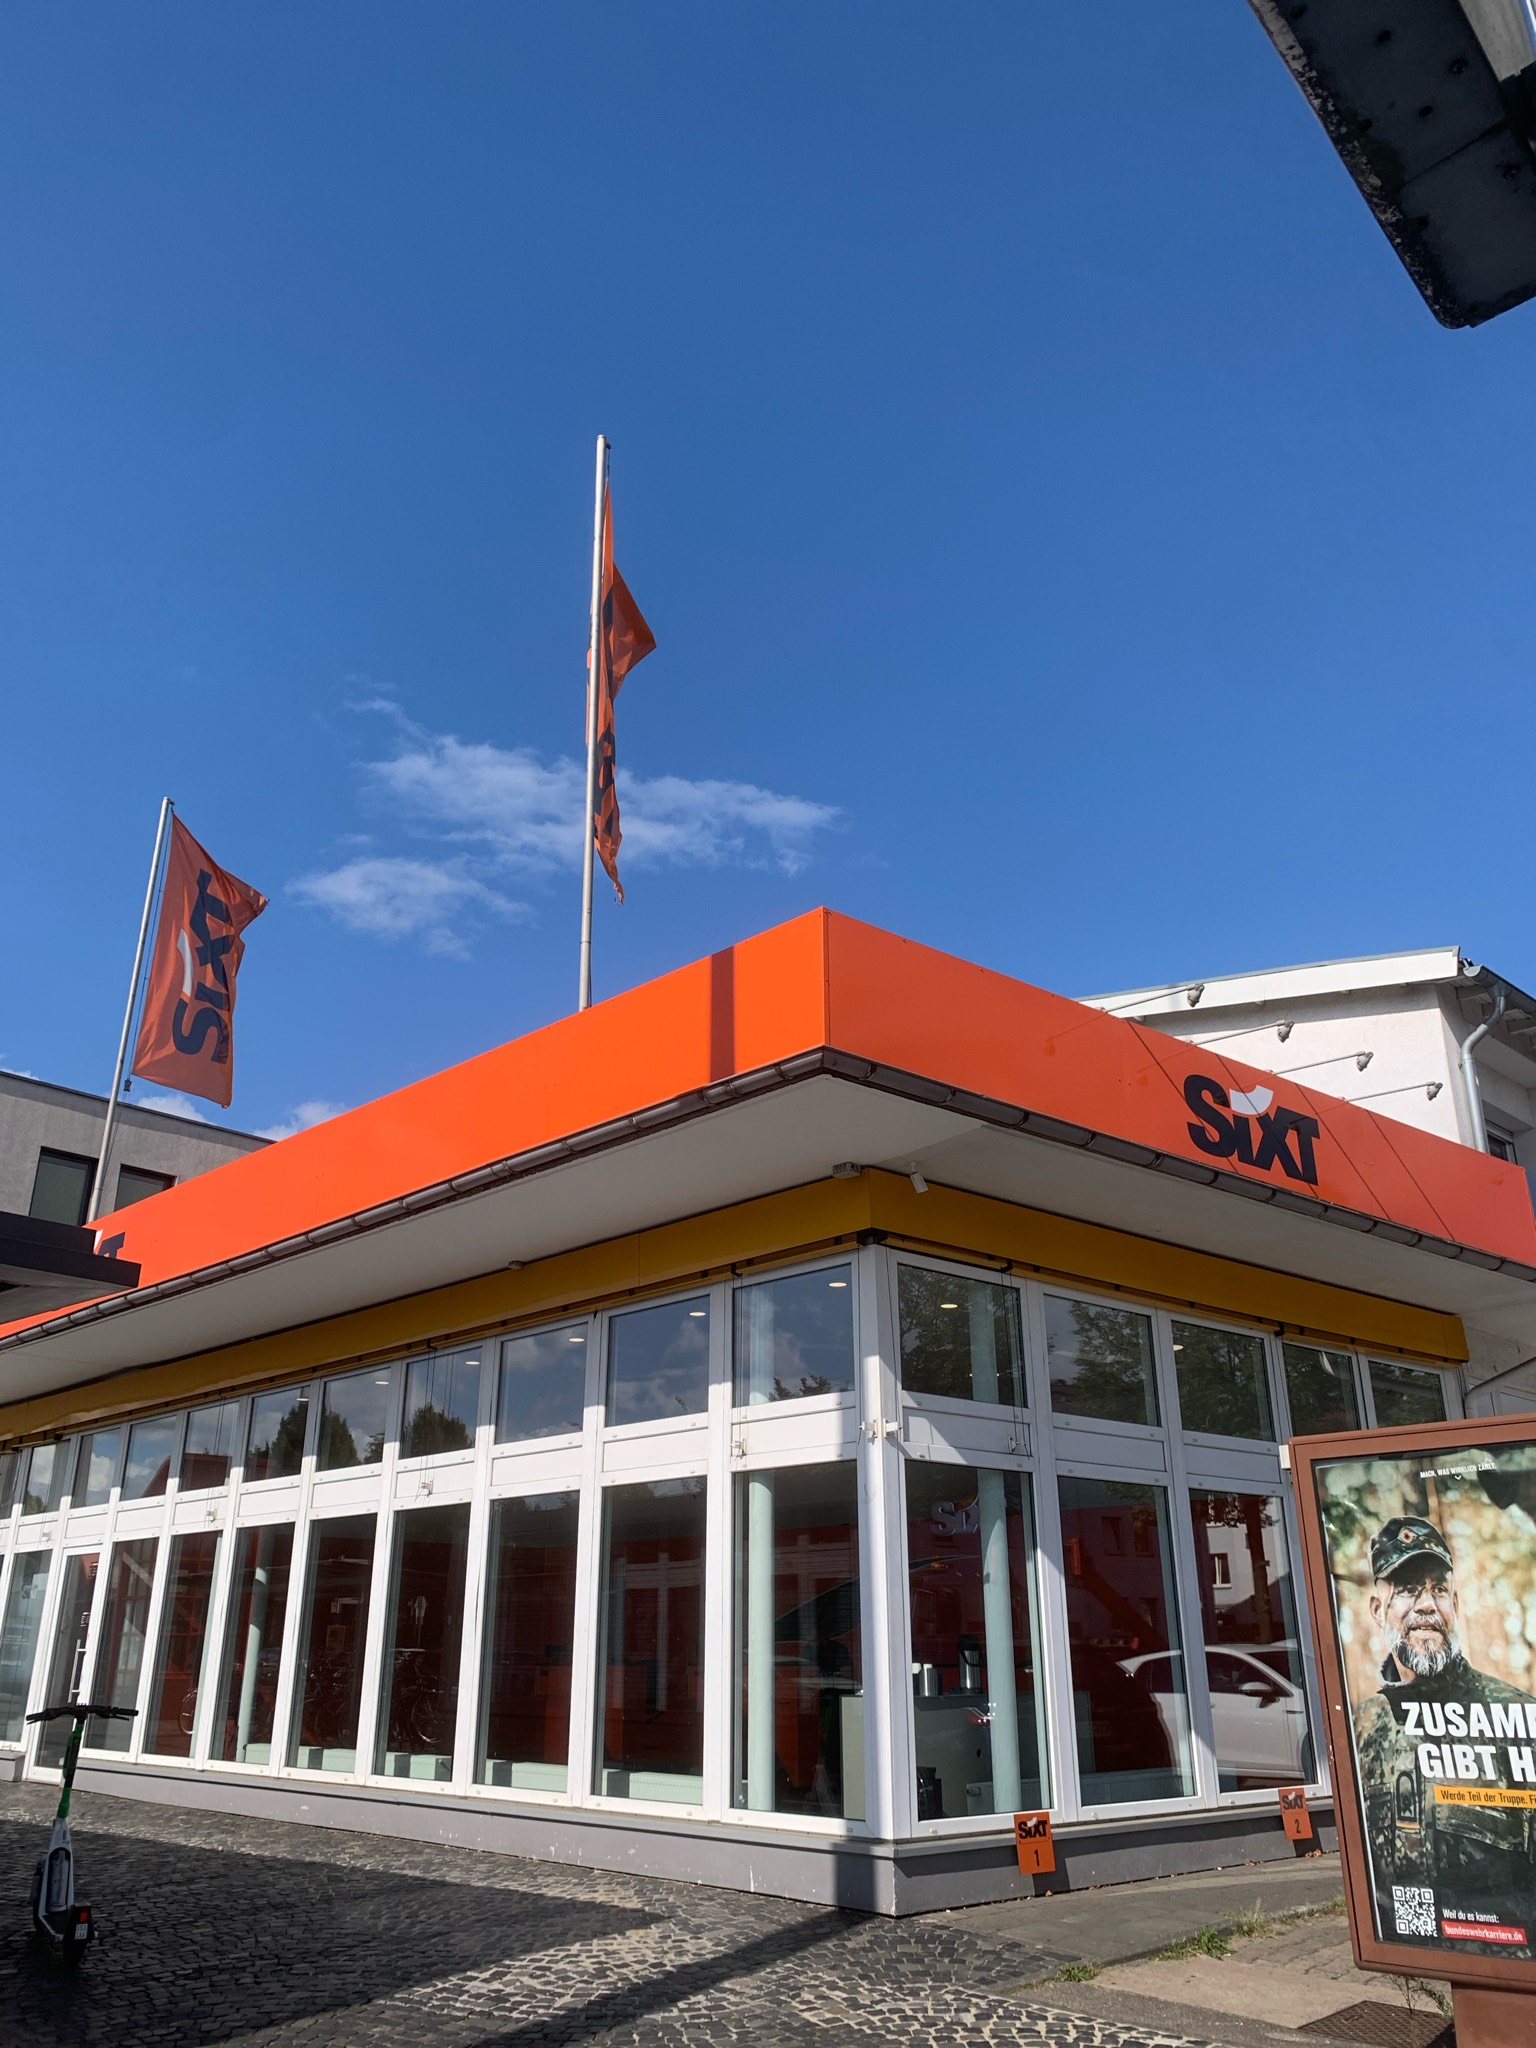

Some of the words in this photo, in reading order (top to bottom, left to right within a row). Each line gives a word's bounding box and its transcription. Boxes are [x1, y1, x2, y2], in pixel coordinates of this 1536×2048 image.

[1183, 1074, 1321, 1186] SIXT
[1437, 1468, 1450, 1476] WAS
[1417, 1743, 1497, 1780] GIBT
[1440, 1790, 1465, 1801] Werde
[1467, 1791, 1481, 1802] Teil
[1483, 1792, 1496, 1803] der
[1498, 1793, 1528, 1806] Truppe.
[1018, 1817, 1047, 1839] SIXT
[1294, 1818, 1301, 1833] 2
[1034, 1849, 1040, 1867] 1
[1442, 1908, 1457, 1918] Weil
[1457, 1910, 1466, 1920] du
[1467, 1912, 1475, 1921] es
[1476, 1911, 1500, 1923] kannst:
[1445, 1925, 1523, 1941] bundeswehrkarriere.de
